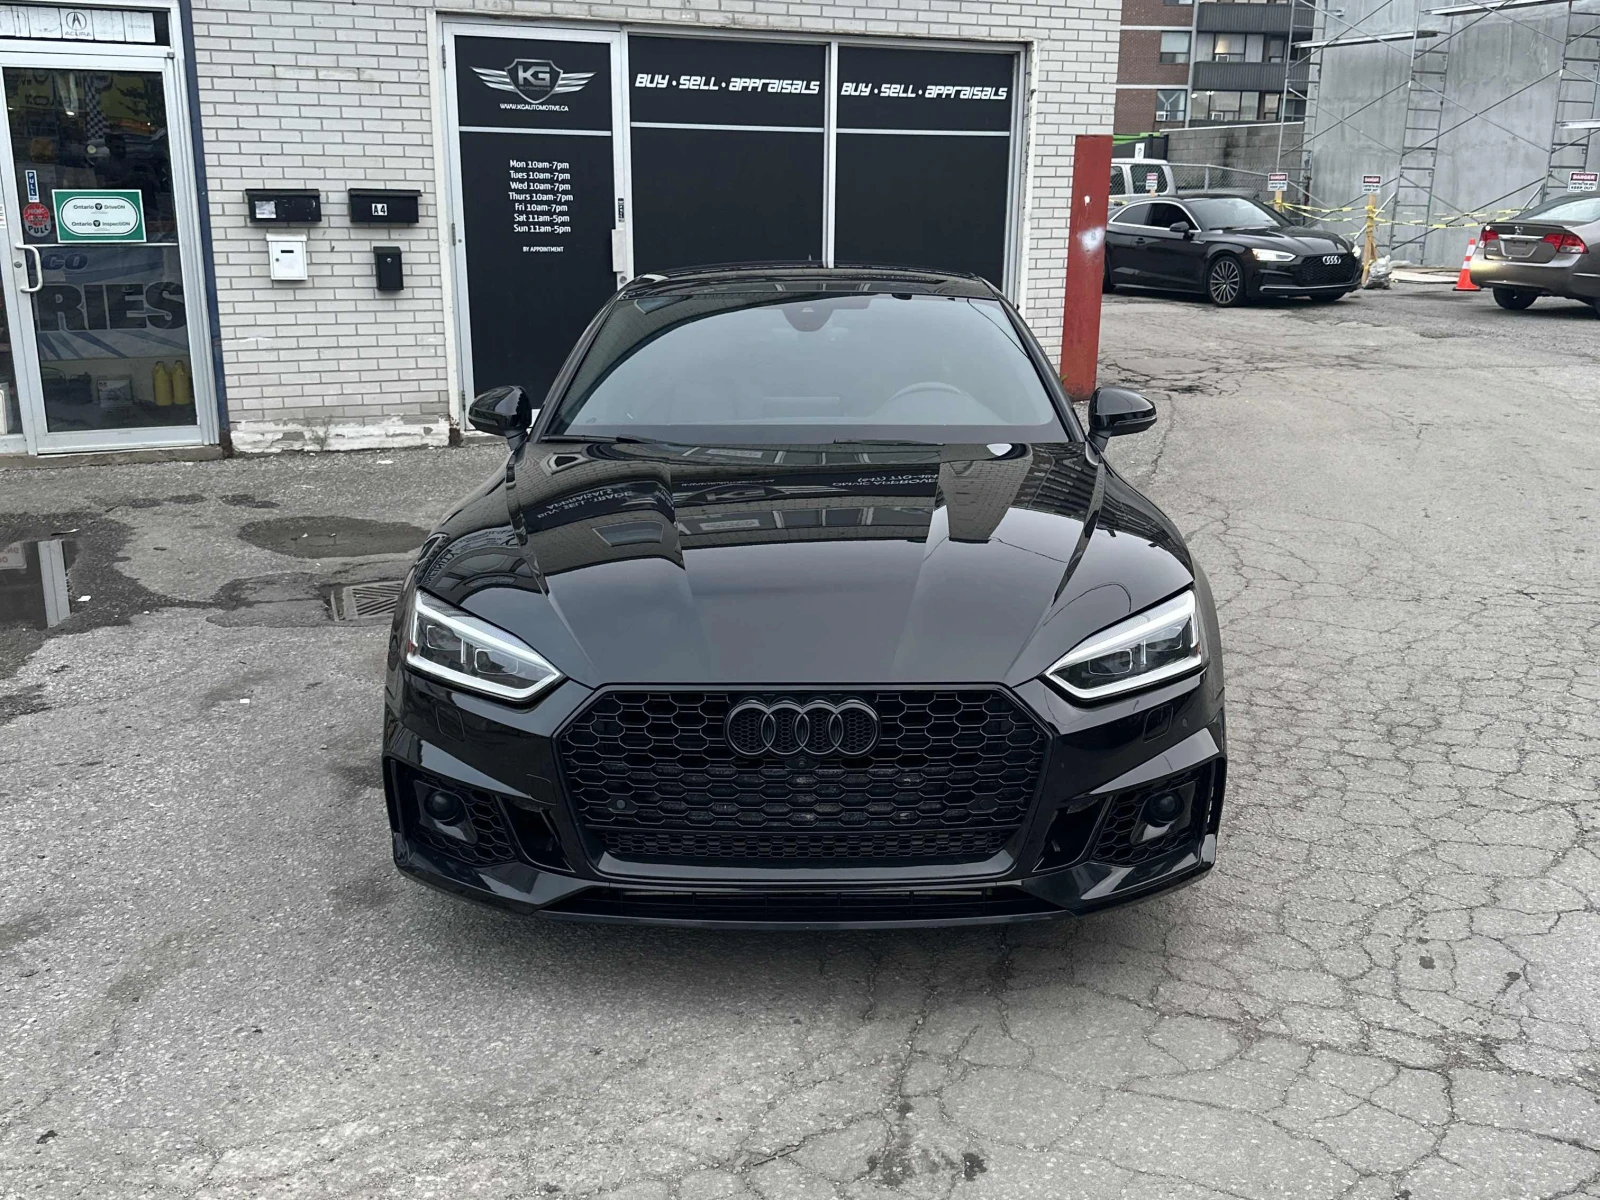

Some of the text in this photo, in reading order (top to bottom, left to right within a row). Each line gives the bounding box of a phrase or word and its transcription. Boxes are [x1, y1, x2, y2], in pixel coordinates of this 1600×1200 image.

[518, 65, 550, 86] KG
[635, 73, 669, 88] BUY
[841, 82, 872, 96] BUY
[500, 103, 569, 112] WWW.KGAUTOMOTIVE.CA
[509, 160, 570, 171] Mon 10am-7pm
[509, 170, 571, 181] Tues 10am-7pm
[510, 181, 571, 192] Wed 10am-7pm
[508, 192, 574, 203] Thurs 10am-7pm
[373, 204, 387, 215] A4
[515, 202, 568, 213] Fri 10am-7pm
[513, 213, 570, 223] Sat 11am-5pm
[28, 224, 49, 234] PULL
[513, 224, 571, 234] Sun 11am-5pm
[36, 281, 187, 331] RIES
